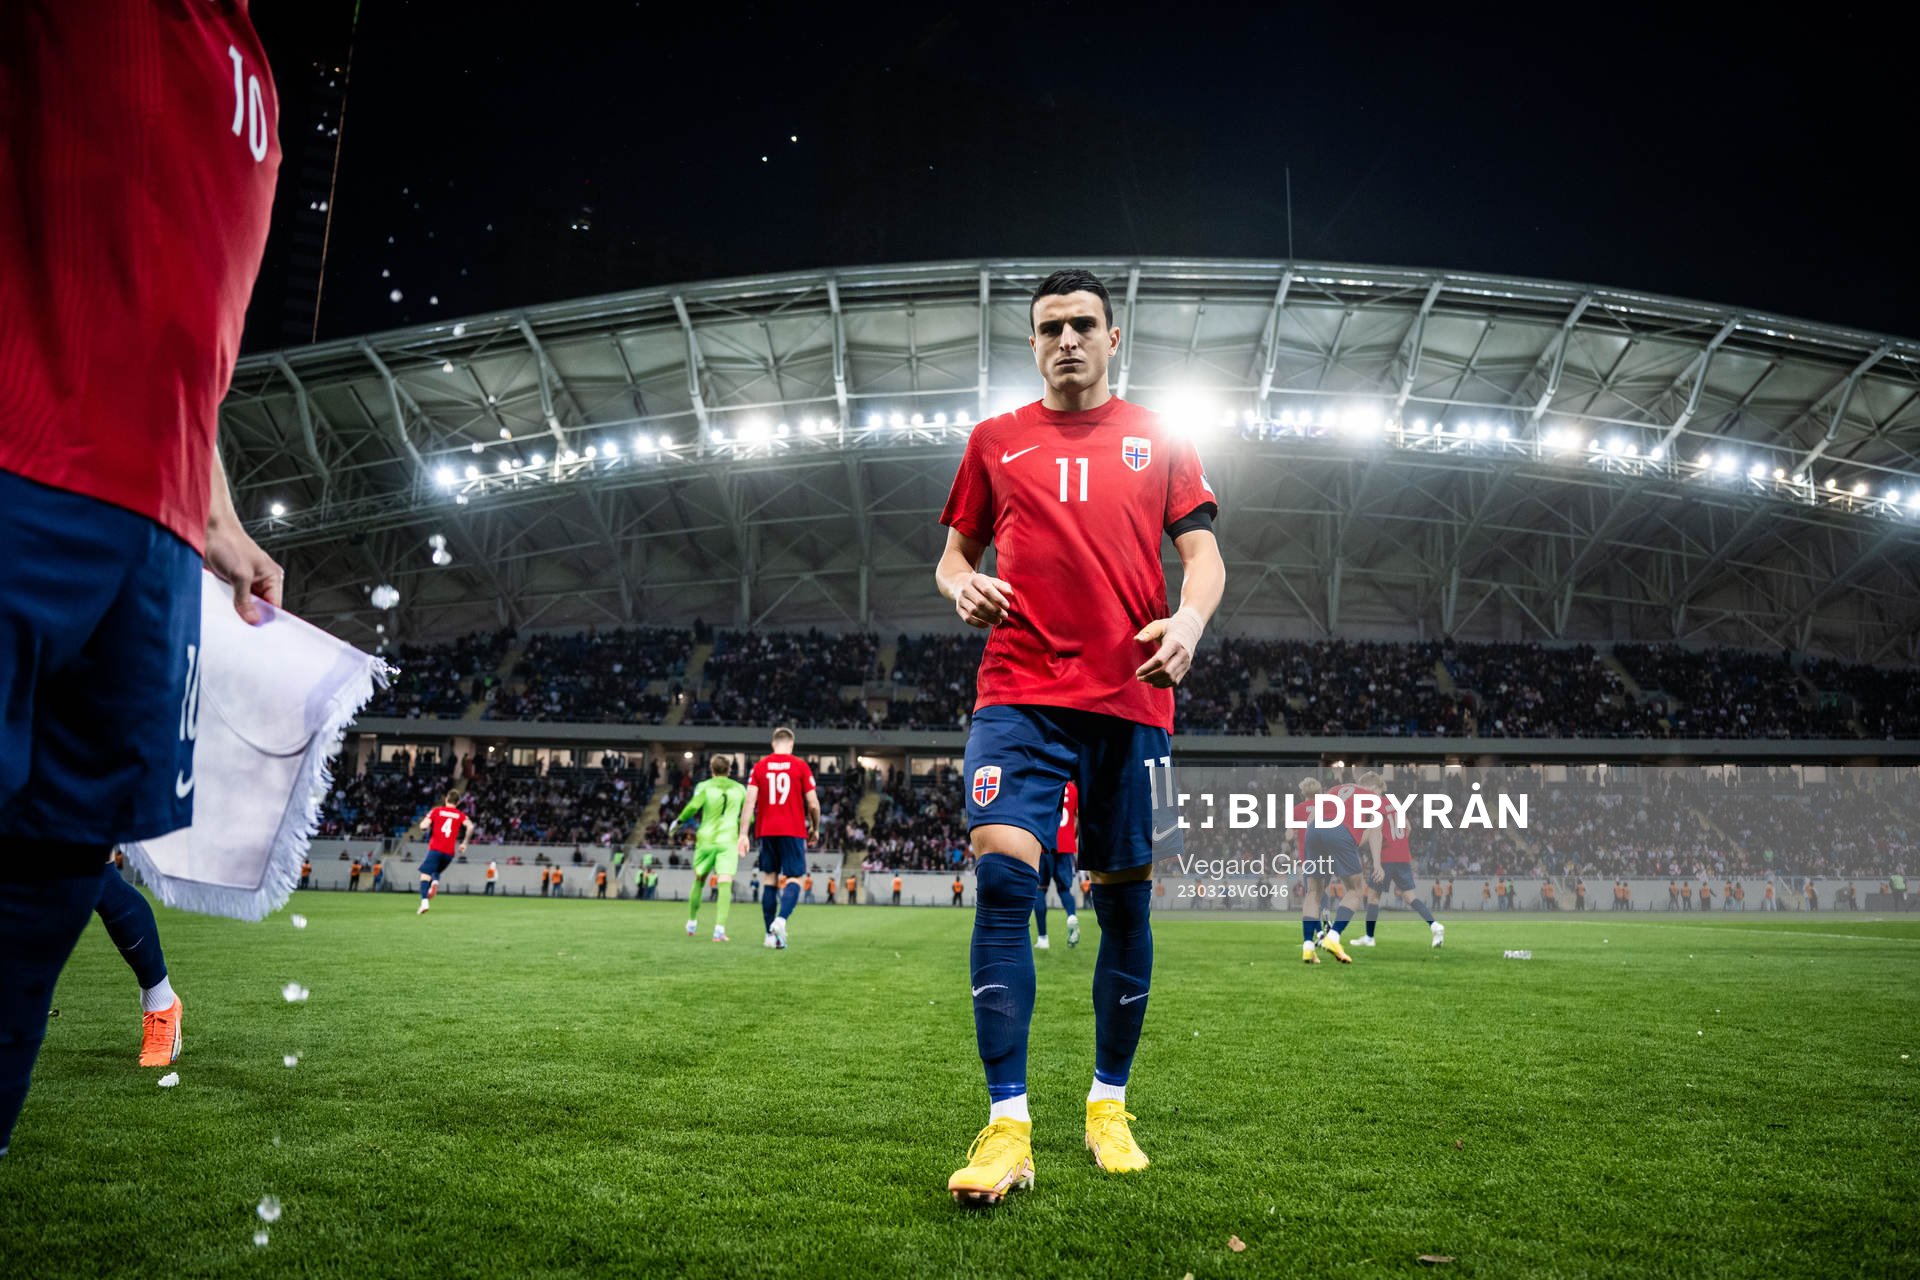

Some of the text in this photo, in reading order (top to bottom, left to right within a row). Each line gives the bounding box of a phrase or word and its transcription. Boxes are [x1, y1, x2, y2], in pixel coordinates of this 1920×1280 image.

[229, 45, 268, 162] 10
[1056, 457, 1089, 502] 11
[766, 772, 791, 805] 19
[1144, 756, 1174, 810] 11
[721, 793, 728, 816] 1
[441, 817, 453, 838] 4
